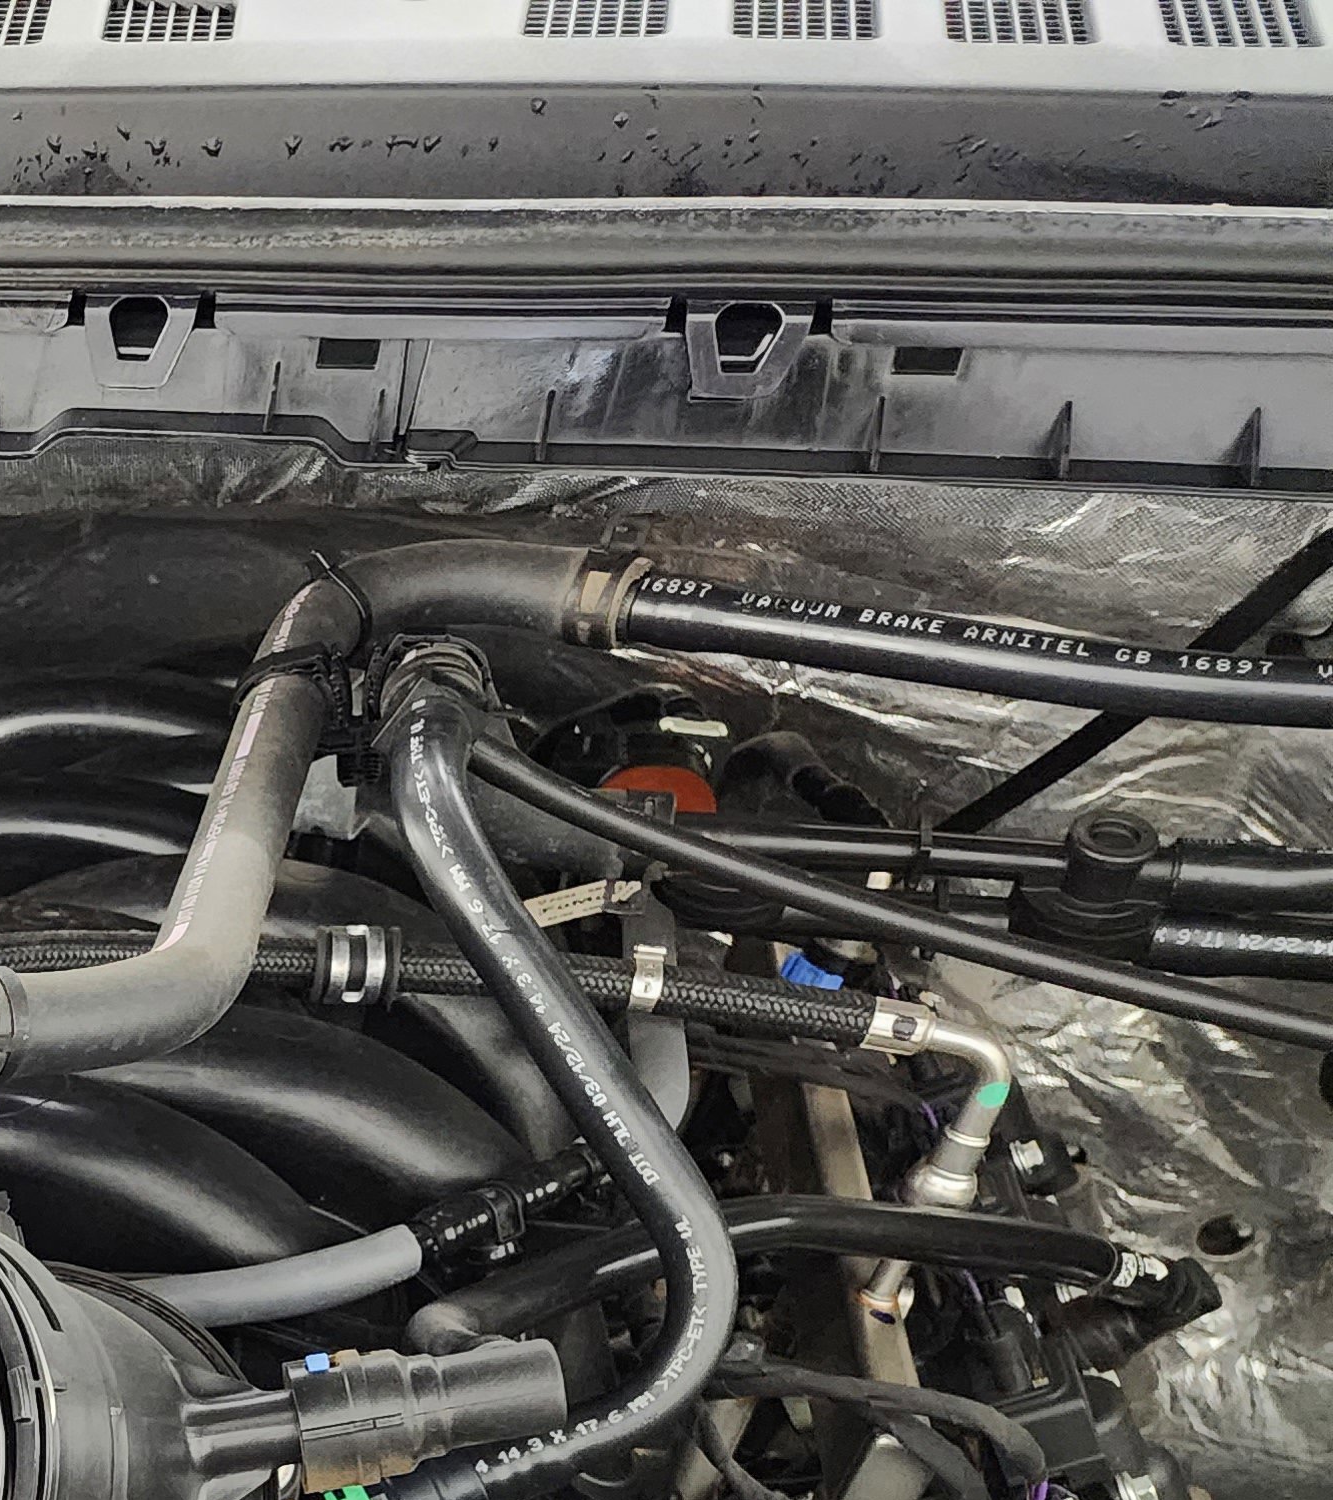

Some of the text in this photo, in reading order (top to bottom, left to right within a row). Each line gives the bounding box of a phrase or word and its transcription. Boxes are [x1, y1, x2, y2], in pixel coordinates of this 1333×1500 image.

[640, 576, 714, 598] 16897
[858, 608, 948, 635] BRAKE
[963, 624, 1091, 657] ARNITEL
[1114, 647, 1152, 665] GB
[1177, 655, 1274, 675] 16897
[685, 1244, 709, 1295] TYPE
